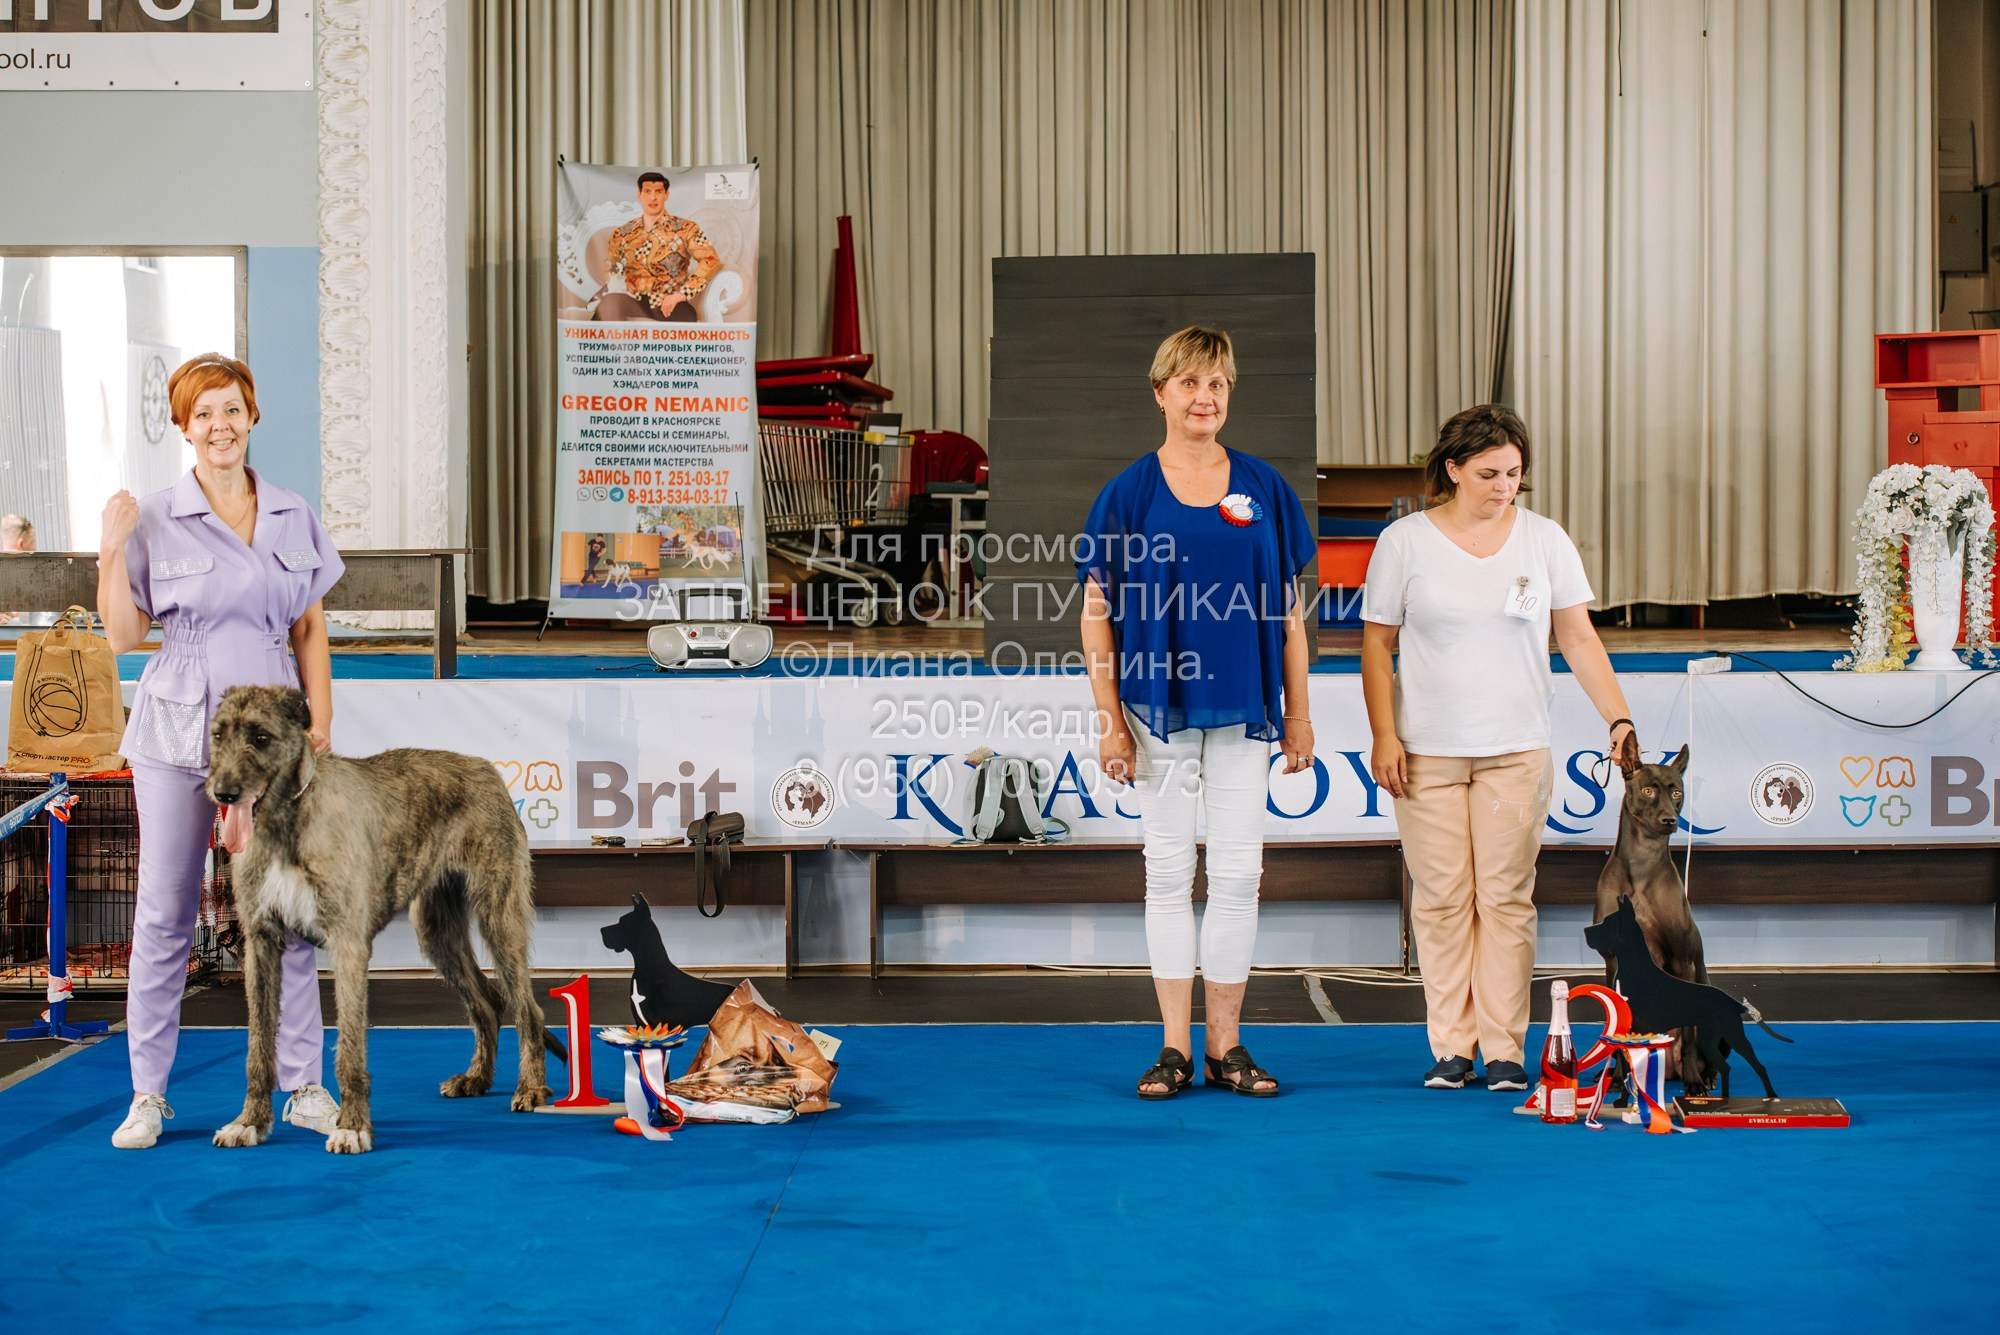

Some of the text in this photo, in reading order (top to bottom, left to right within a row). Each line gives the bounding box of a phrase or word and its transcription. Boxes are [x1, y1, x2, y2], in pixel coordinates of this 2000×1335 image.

[564, 327, 750, 341] УНИКАЛЬНАЯ ВОЗМОЖНОСТЬ
[578, 342, 735, 353] ТРИУМФАТОР МИРОВЫХ РИНГОВ,
[566, 353, 747, 366] УСПЕШНЫЙ ЗАВОДЧИК-СЕЛЕКЦИОНЕР,
[572, 367, 740, 378] ОДИН ИЗ САМЫХ ХАРИЗМАТИЧНЫХ
[613, 380, 699, 390] ХЭНДЛЕРОВ МИРА
[561, 394, 749, 412] GREGOR NEMANIC
[590, 416, 721, 427] ПРОВОДИТ В КРАСНОЯРСКЕ
[580, 429, 730, 440] МАСТЕР-КЛАССЫ И СЕМИНАРЫ,
[561, 442, 748, 453] ДЕЛИТСЯ СВОИМИ ИСКЛЮЧИТЕЛЬНЫМИ
[595, 457, 714, 467] СЕКРЕТАМИ МАСТЕРСТВА
[578, 469, 729, 486] ЗАПИСЬ ПО Т. 251-03-17
[627, 488, 728, 505] 8-913-534-03-17
[1515, 594, 1538, 611] 40
[71, 756, 91, 765] PRO
[577, 761, 737, 829] Brit
[1931, 756, 2000, 827] B
[549, 974, 610, 1107] 1
